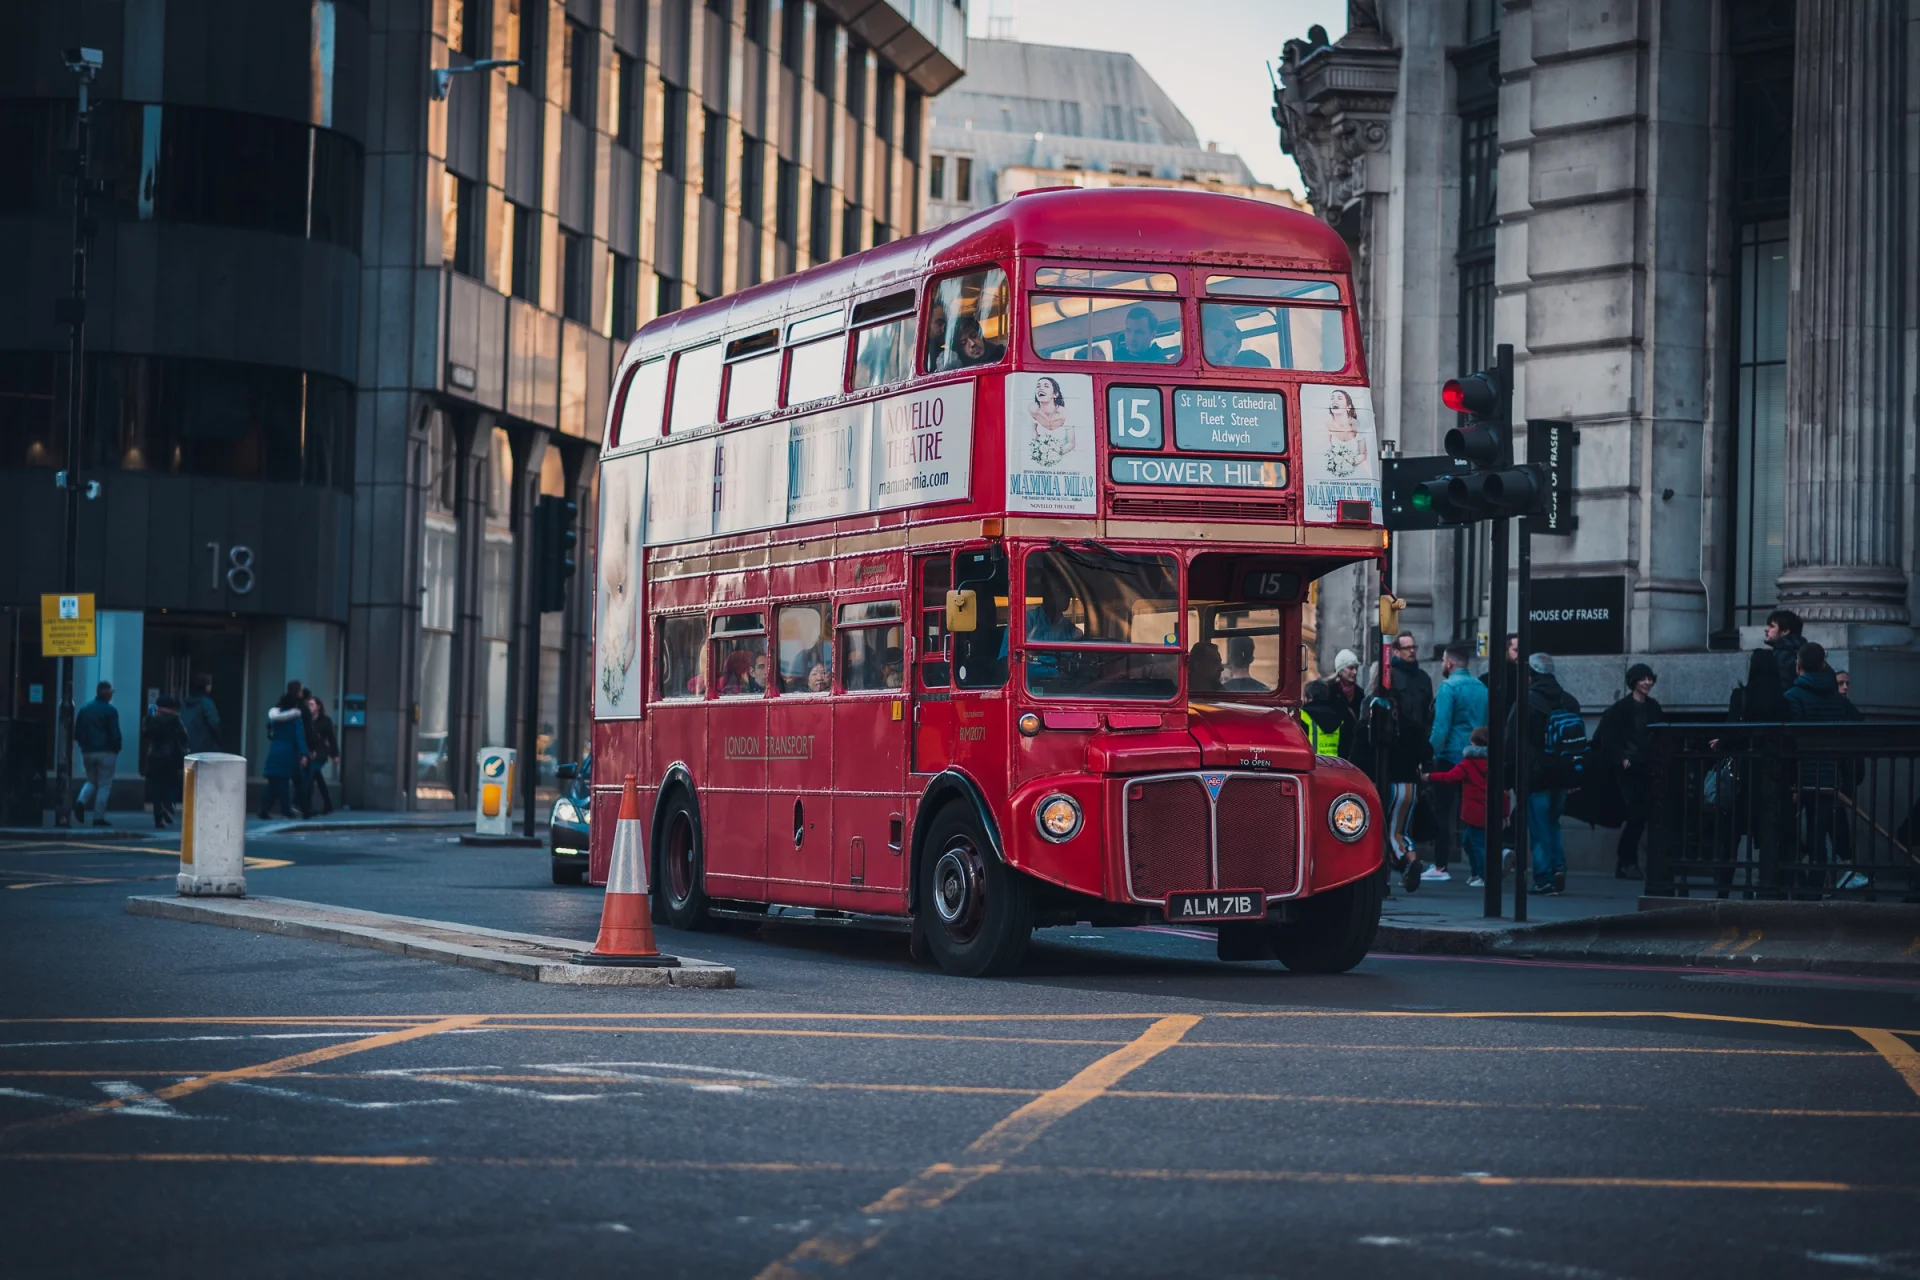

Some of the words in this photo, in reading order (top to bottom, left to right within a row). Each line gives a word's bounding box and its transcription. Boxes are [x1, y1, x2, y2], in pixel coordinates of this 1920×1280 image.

[1181, 394, 1191, 407] St
[1196, 395, 1227, 408] Paul's
[1232, 396, 1277, 410] Cathedral
[887, 398, 943, 435] NOVELLO
[1117, 398, 1151, 438] 15
[1200, 412, 1225, 425] Fleet
[1231, 413, 1259, 427] Street
[887, 431, 943, 468] THEATRE
[1212, 430, 1250, 447] Aldwych
[1550, 427, 1558, 467] FRASER
[1128, 460, 1214, 483] TOWER
[1225, 463, 1273, 485] HILL
[1010, 474, 1061, 496] MAMMA
[1063, 476, 1094, 497] MIA!
[207, 542, 255, 594] 18
[1260, 573, 1282, 595] 15
[1529, 609, 1560, 621] HOUSE
[1561, 609, 1574, 621] OF
[1576, 608, 1609, 620] FRASER
[960, 726, 986, 742] RM2071
[724, 736, 760, 760] LONDON
[765, 735, 815, 760] TRANSPORT
[1182, 898, 1219, 915] ALM
[1222, 896, 1252, 914] 71B
